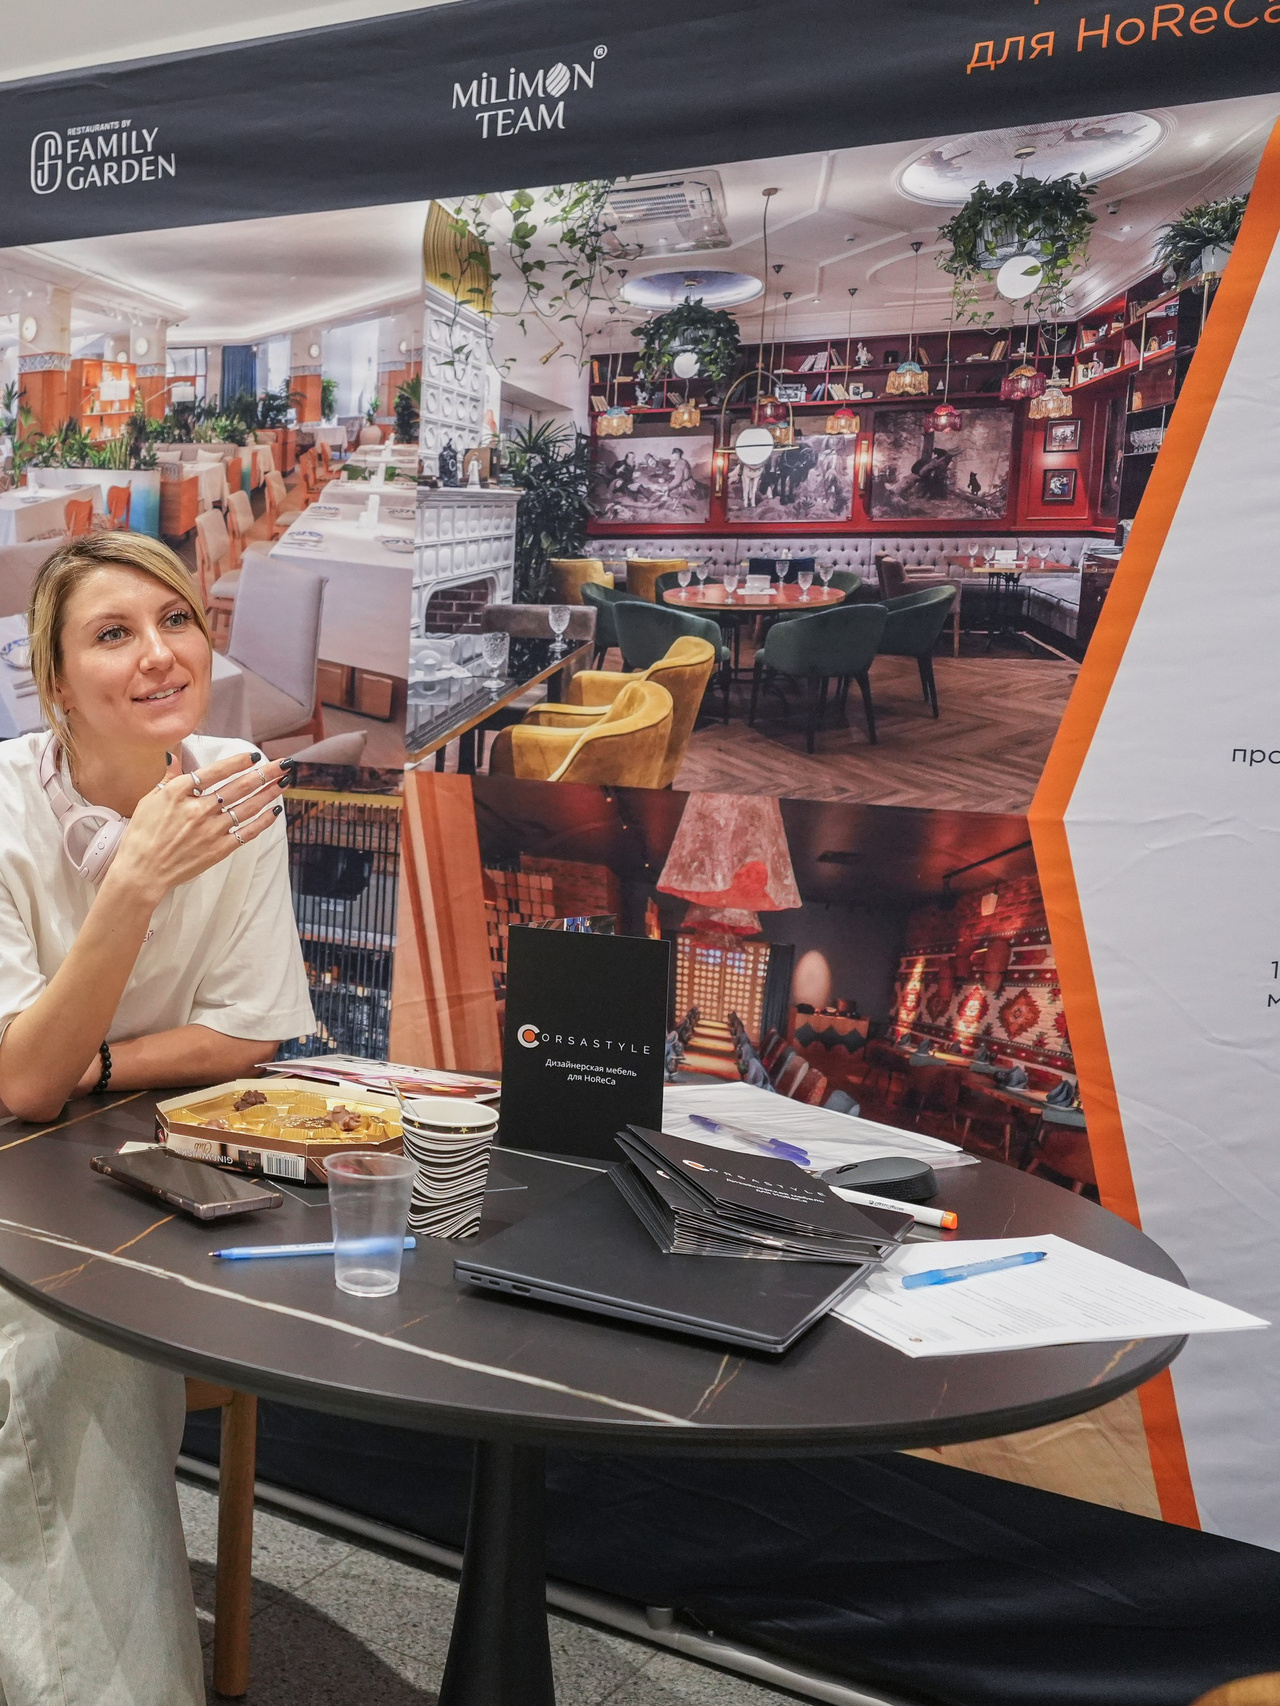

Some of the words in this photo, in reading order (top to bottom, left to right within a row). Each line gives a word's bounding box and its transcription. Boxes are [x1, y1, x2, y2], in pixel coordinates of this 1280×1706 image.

[966, 31, 1055, 74] для
[67, 121, 120, 136] RESTAURANTS
[121, 119, 132, 128] BY
[475, 101, 566, 139] TEAM
[66, 127, 159, 164] FAMILY
[66, 153, 176, 190] GARDEN
[517, 1024, 651, 1054] CORSASTYLE
[545, 1058, 604, 1073] Дизайнерская
[606, 1067, 638, 1077] мебель
[584, 1075, 616, 1086] HoReCa
